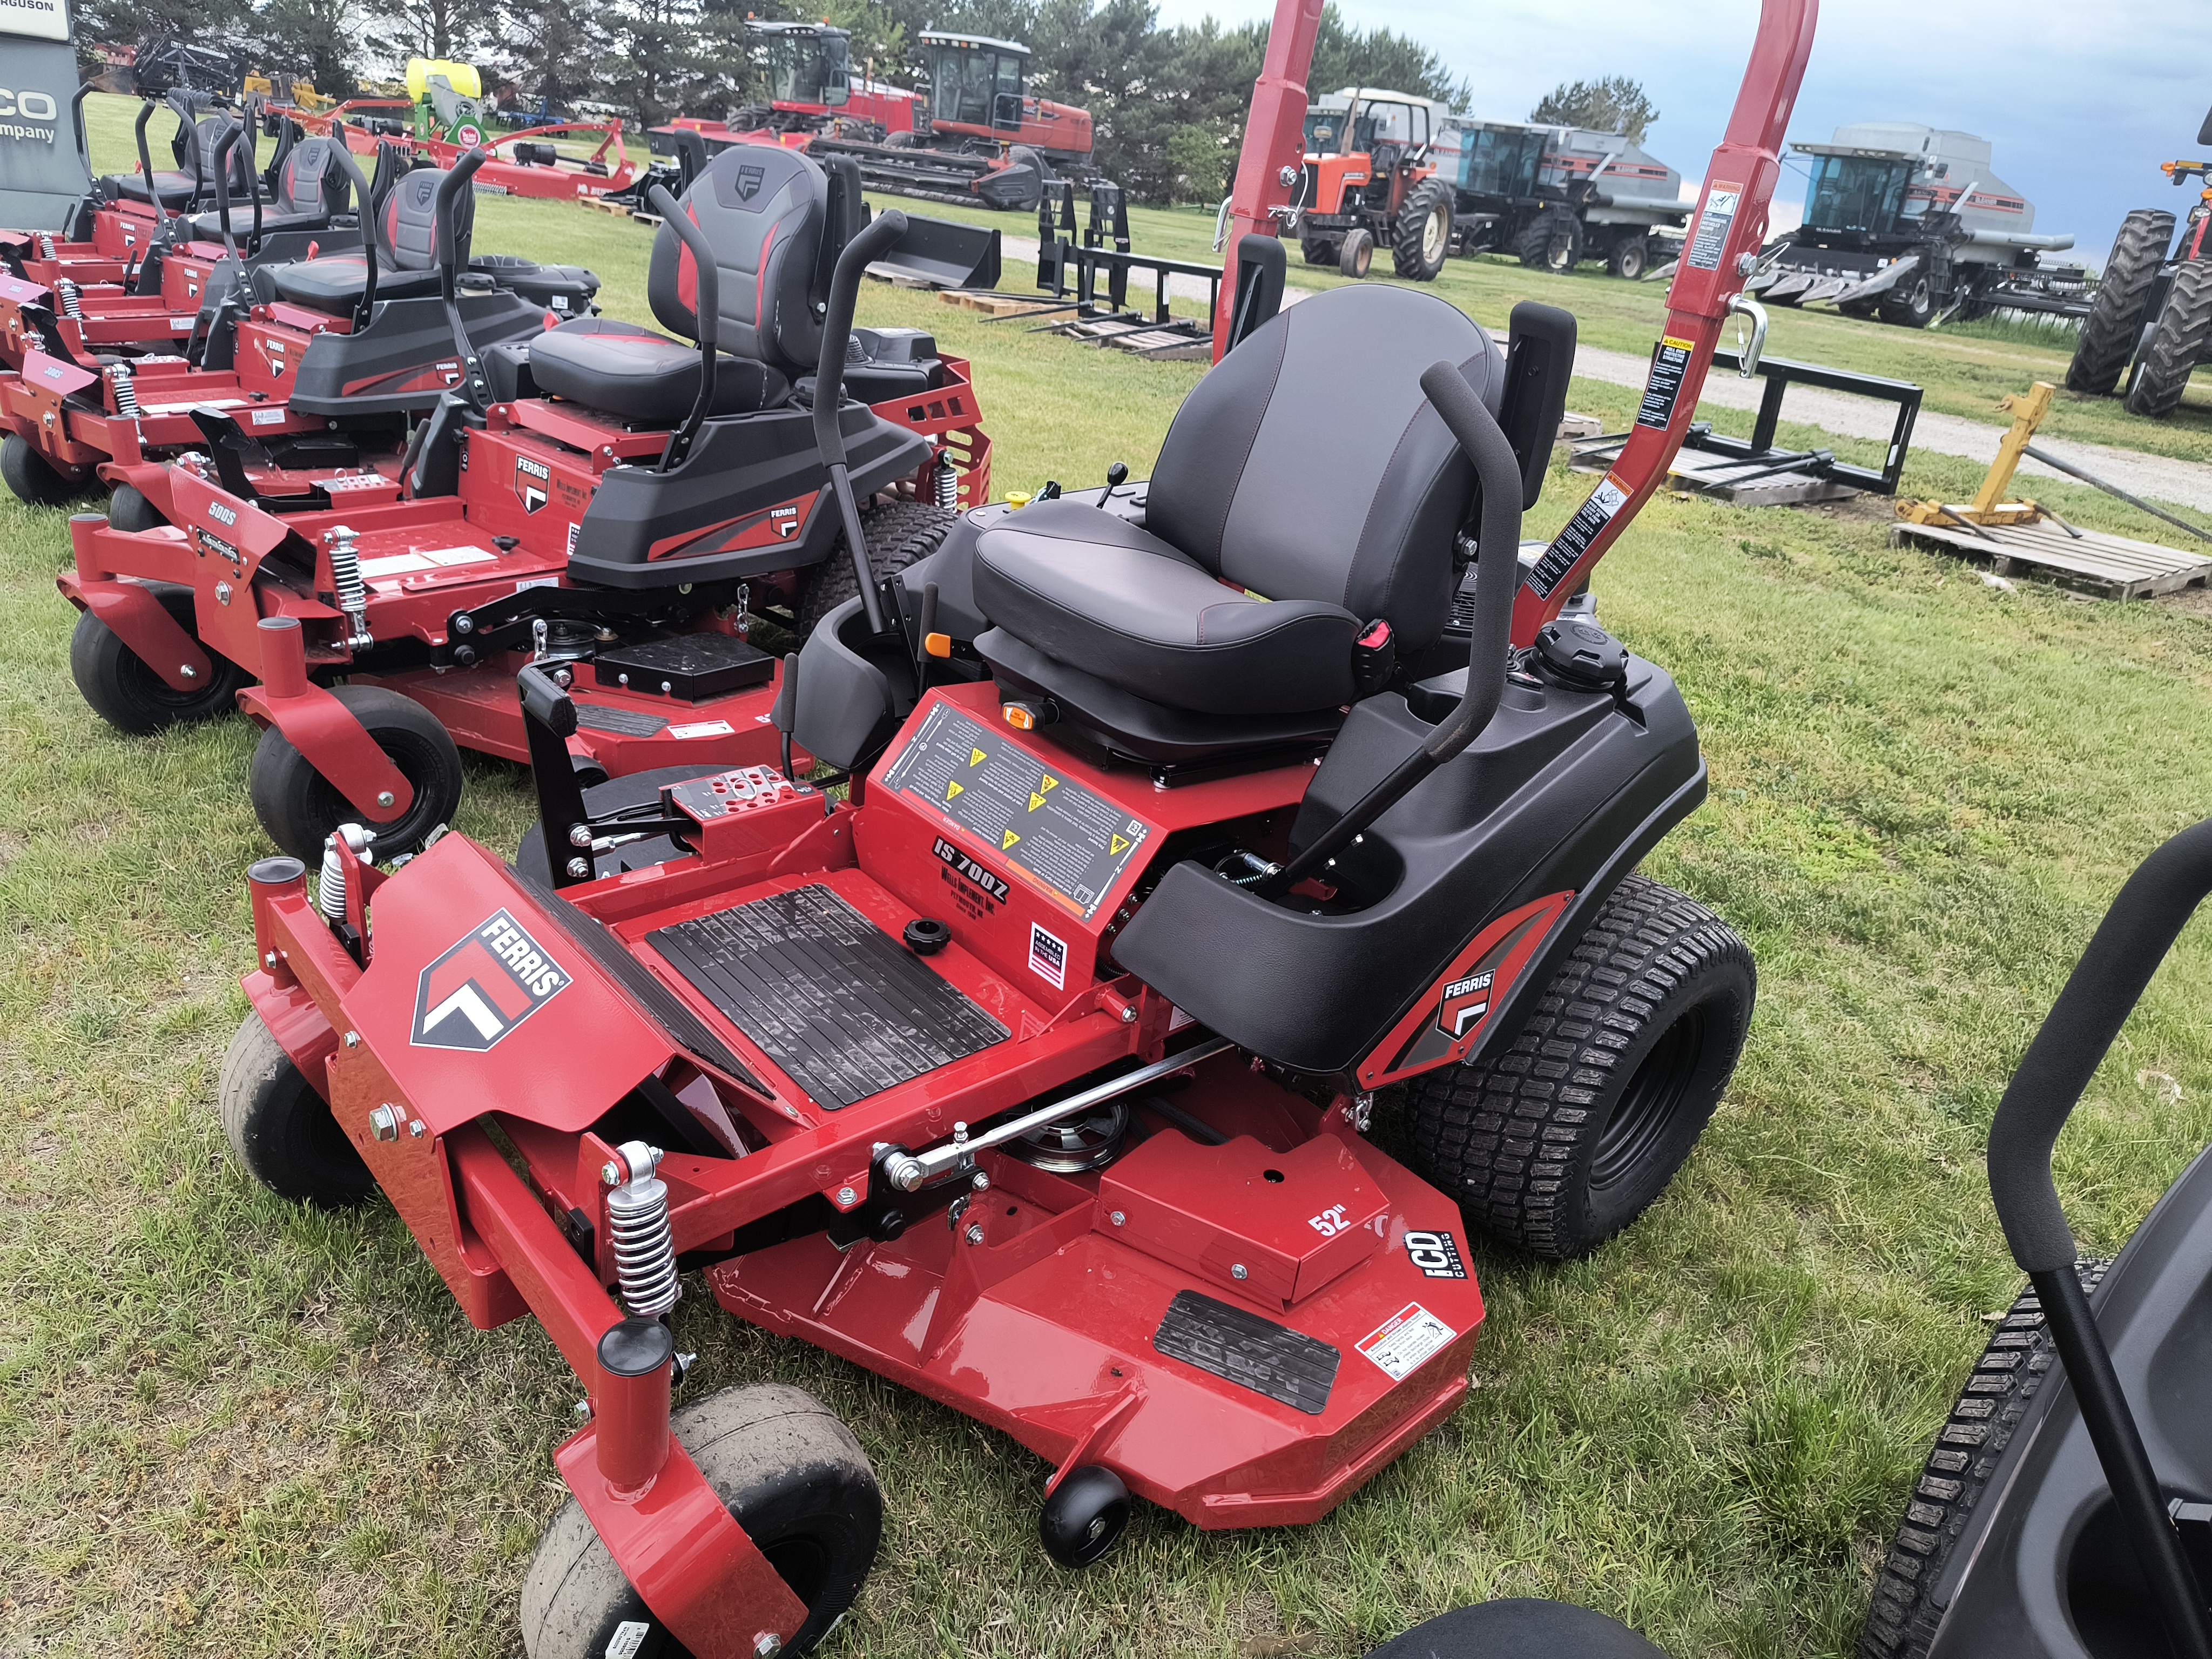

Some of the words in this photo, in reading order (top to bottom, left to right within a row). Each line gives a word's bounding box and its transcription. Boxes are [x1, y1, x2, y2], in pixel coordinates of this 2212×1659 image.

[267, 339, 284, 353] FERRIS
[1669, 340, 1692, 349] CAUTION
[518, 457, 548, 479] FERRIS
[1612, 477, 1630, 495] WARNING
[208, 501, 237, 525] 500S
[771, 508, 797, 517] FERRIS
[941, 815, 961, 831] DANGER
[934, 838, 955, 862] IS
[957, 853, 1008, 901] 700Z
[1031, 876, 1054, 894] WARNING
[480, 916, 559, 996] FERRIS
[1035, 940, 1060, 960] ASSEMBLED
[1049, 955, 1060, 967] USA
[1445, 973, 1491, 999] FERRIS
[1307, 1204, 1351, 1236] 52"
[1441, 1233, 1465, 1278] CUTTING
[1381, 1317, 1404, 1335] DANGER
